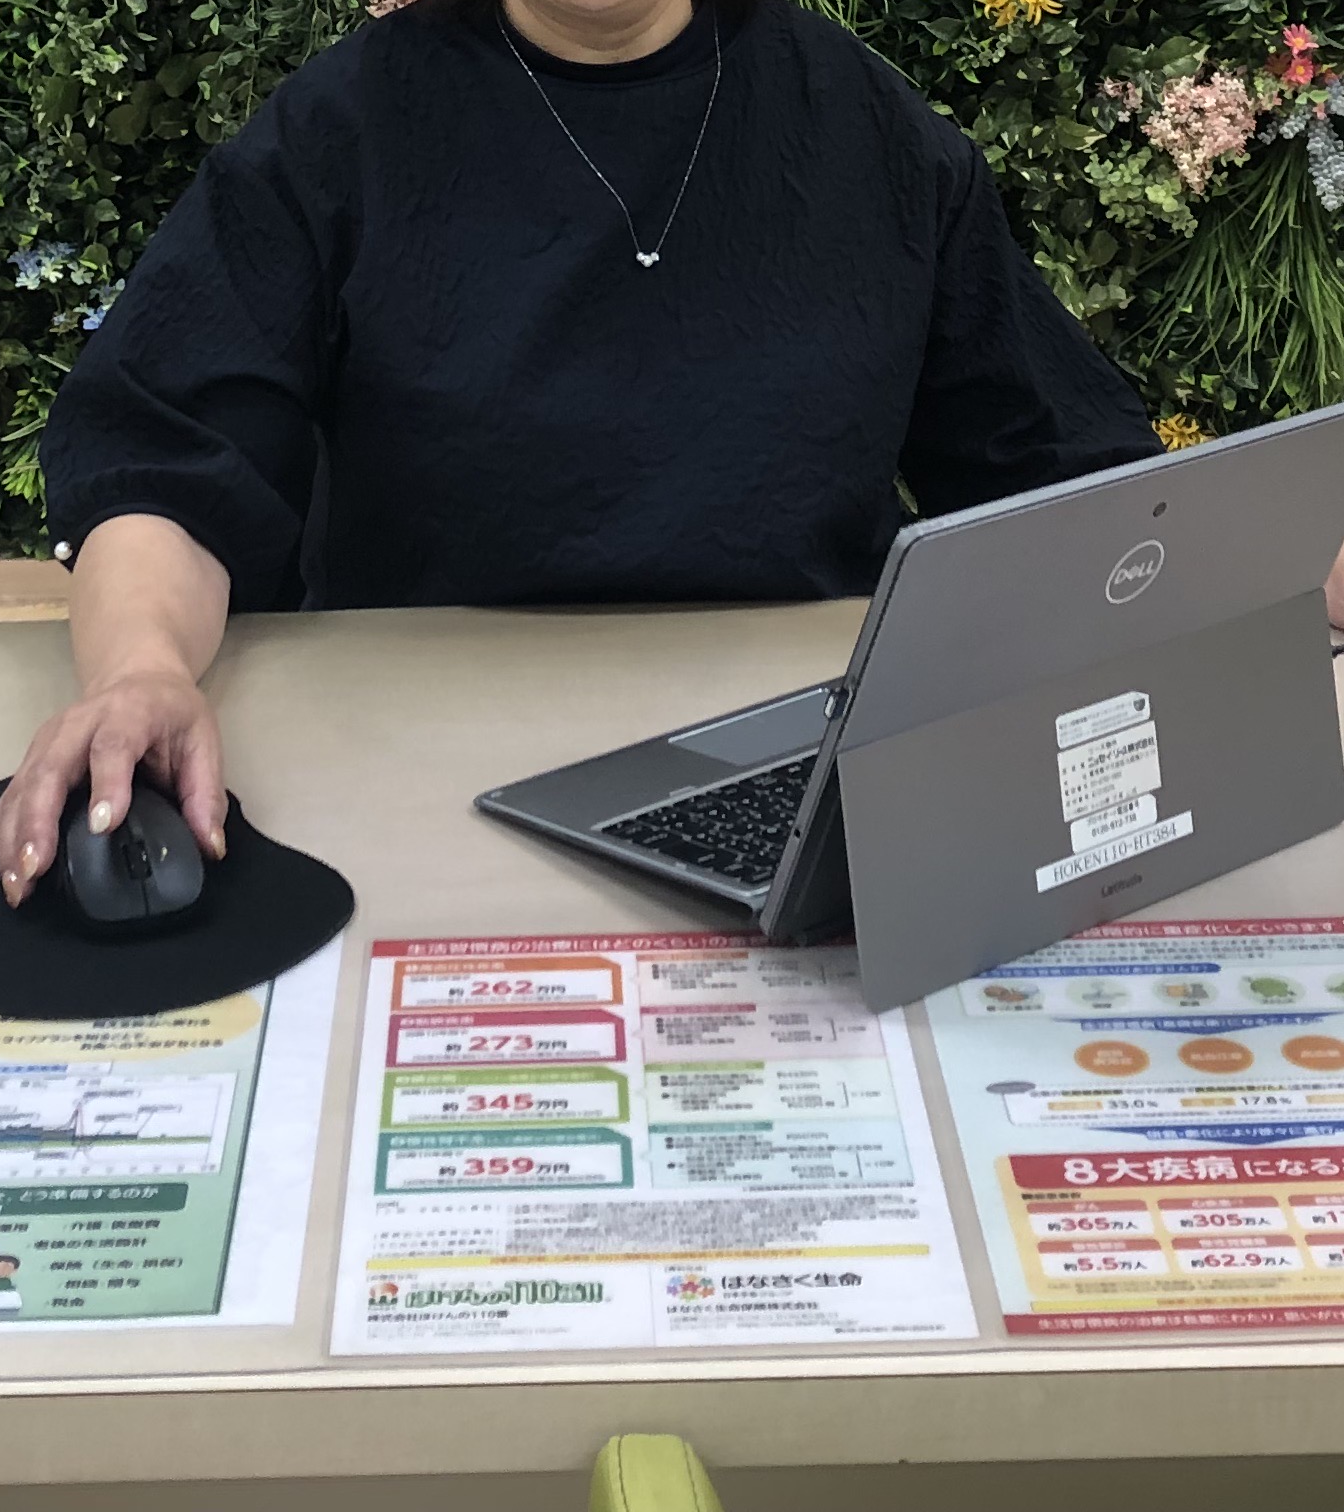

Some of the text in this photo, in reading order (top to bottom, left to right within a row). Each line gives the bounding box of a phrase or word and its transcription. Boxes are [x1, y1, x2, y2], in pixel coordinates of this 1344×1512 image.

[1114, 560, 1156, 585] DELL
[1053, 823, 1178, 883] HOKEN110-HT384
[407, 936, 770, 956] 生活習慣病の治療にはどのくらいの
[1047, 1217, 1139, 1232] 約365万人
[1180, 1213, 1271, 1228] 約305万人
[1063, 1256, 1148, 1272] 約5.5万人
[1191, 1252, 1293, 1269] 約62.9万人
[721, 1271, 863, 1289] はなさく生命
